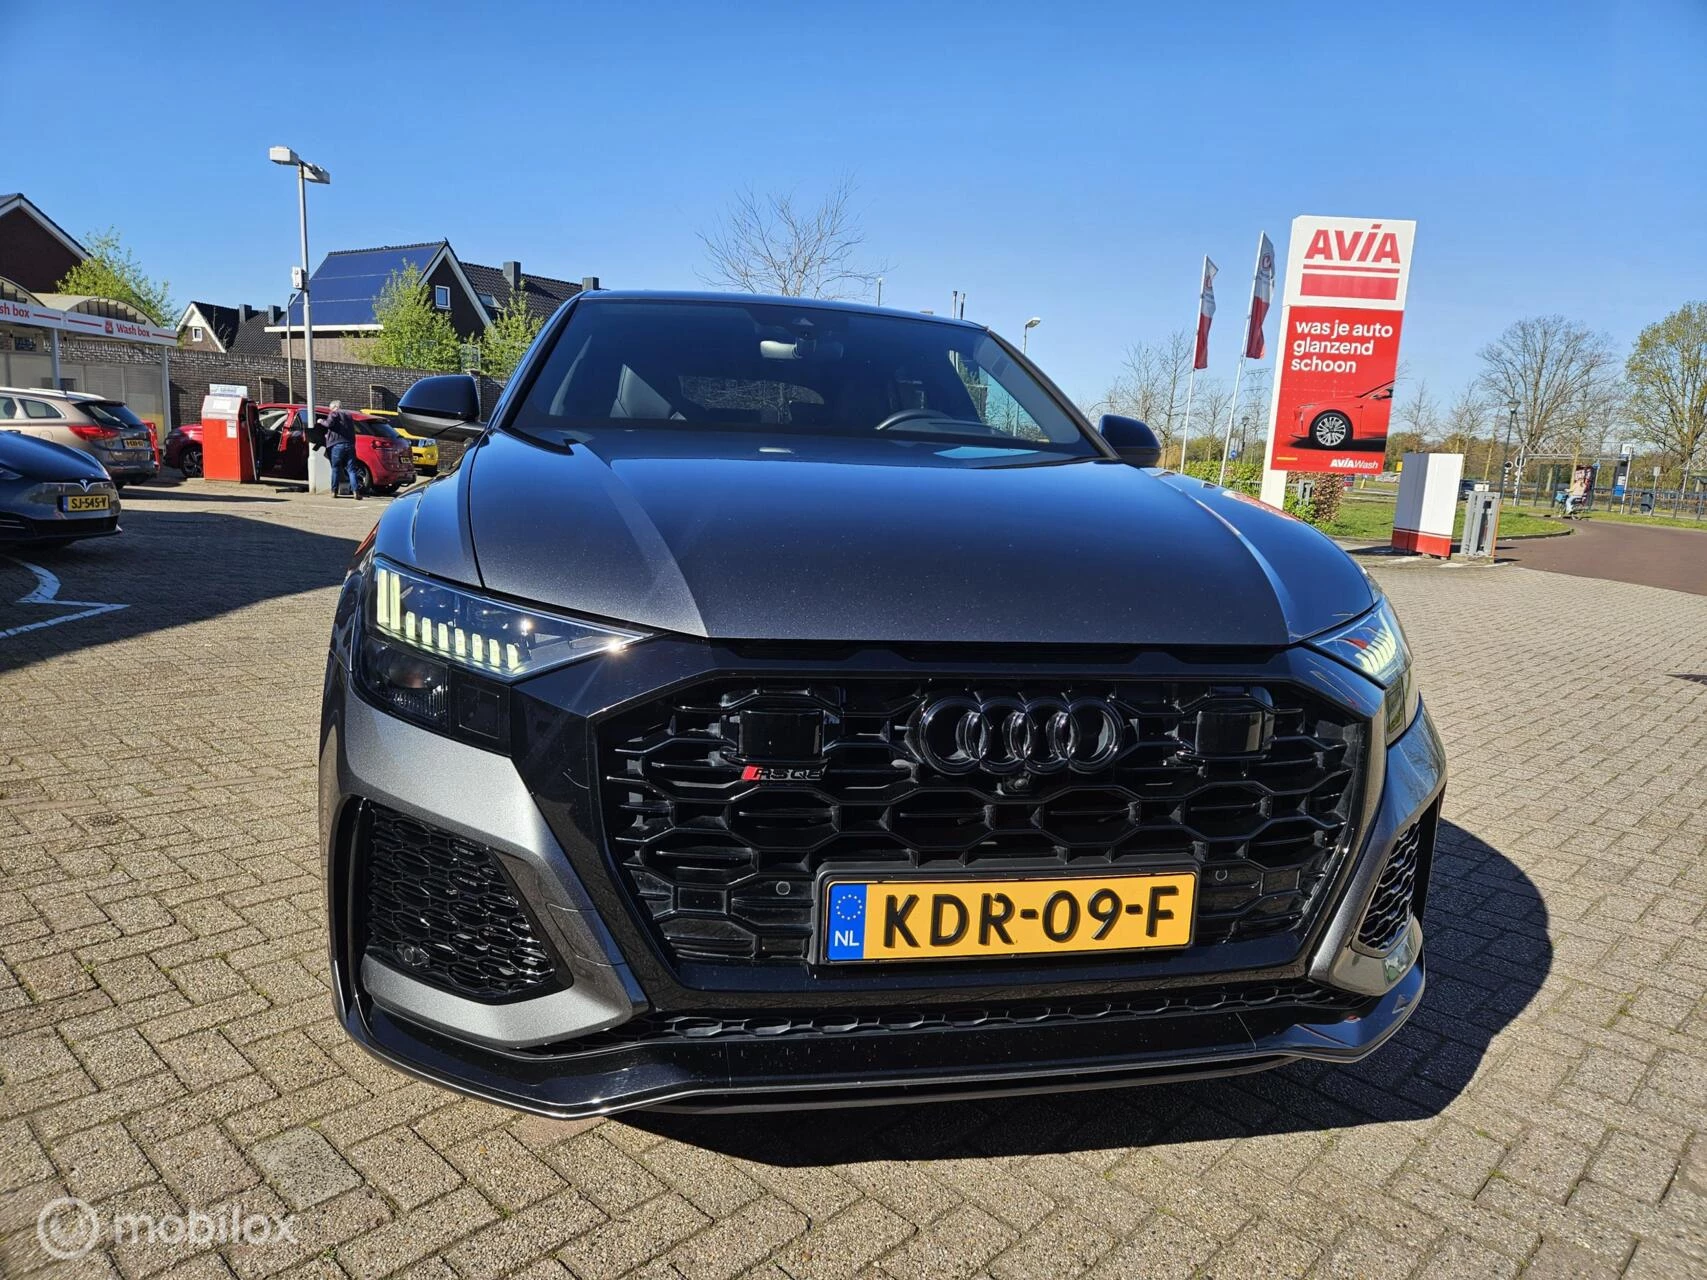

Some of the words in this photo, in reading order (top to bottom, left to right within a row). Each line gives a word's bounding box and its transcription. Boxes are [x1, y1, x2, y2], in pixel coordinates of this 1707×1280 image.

[12, 304, 30, 319] box
[116, 323, 137, 336] Wash
[137, 325, 150, 338] box
[1296, 321, 1331, 335] was
[1331, 320, 1350, 339] je
[1352, 323, 1393, 338] auto
[1293, 337, 1375, 356] glanzend
[1291, 355, 1357, 373] schoon
[834, 930, 860, 947] NL
[884, 885, 1180, 949] KDR-09-F
